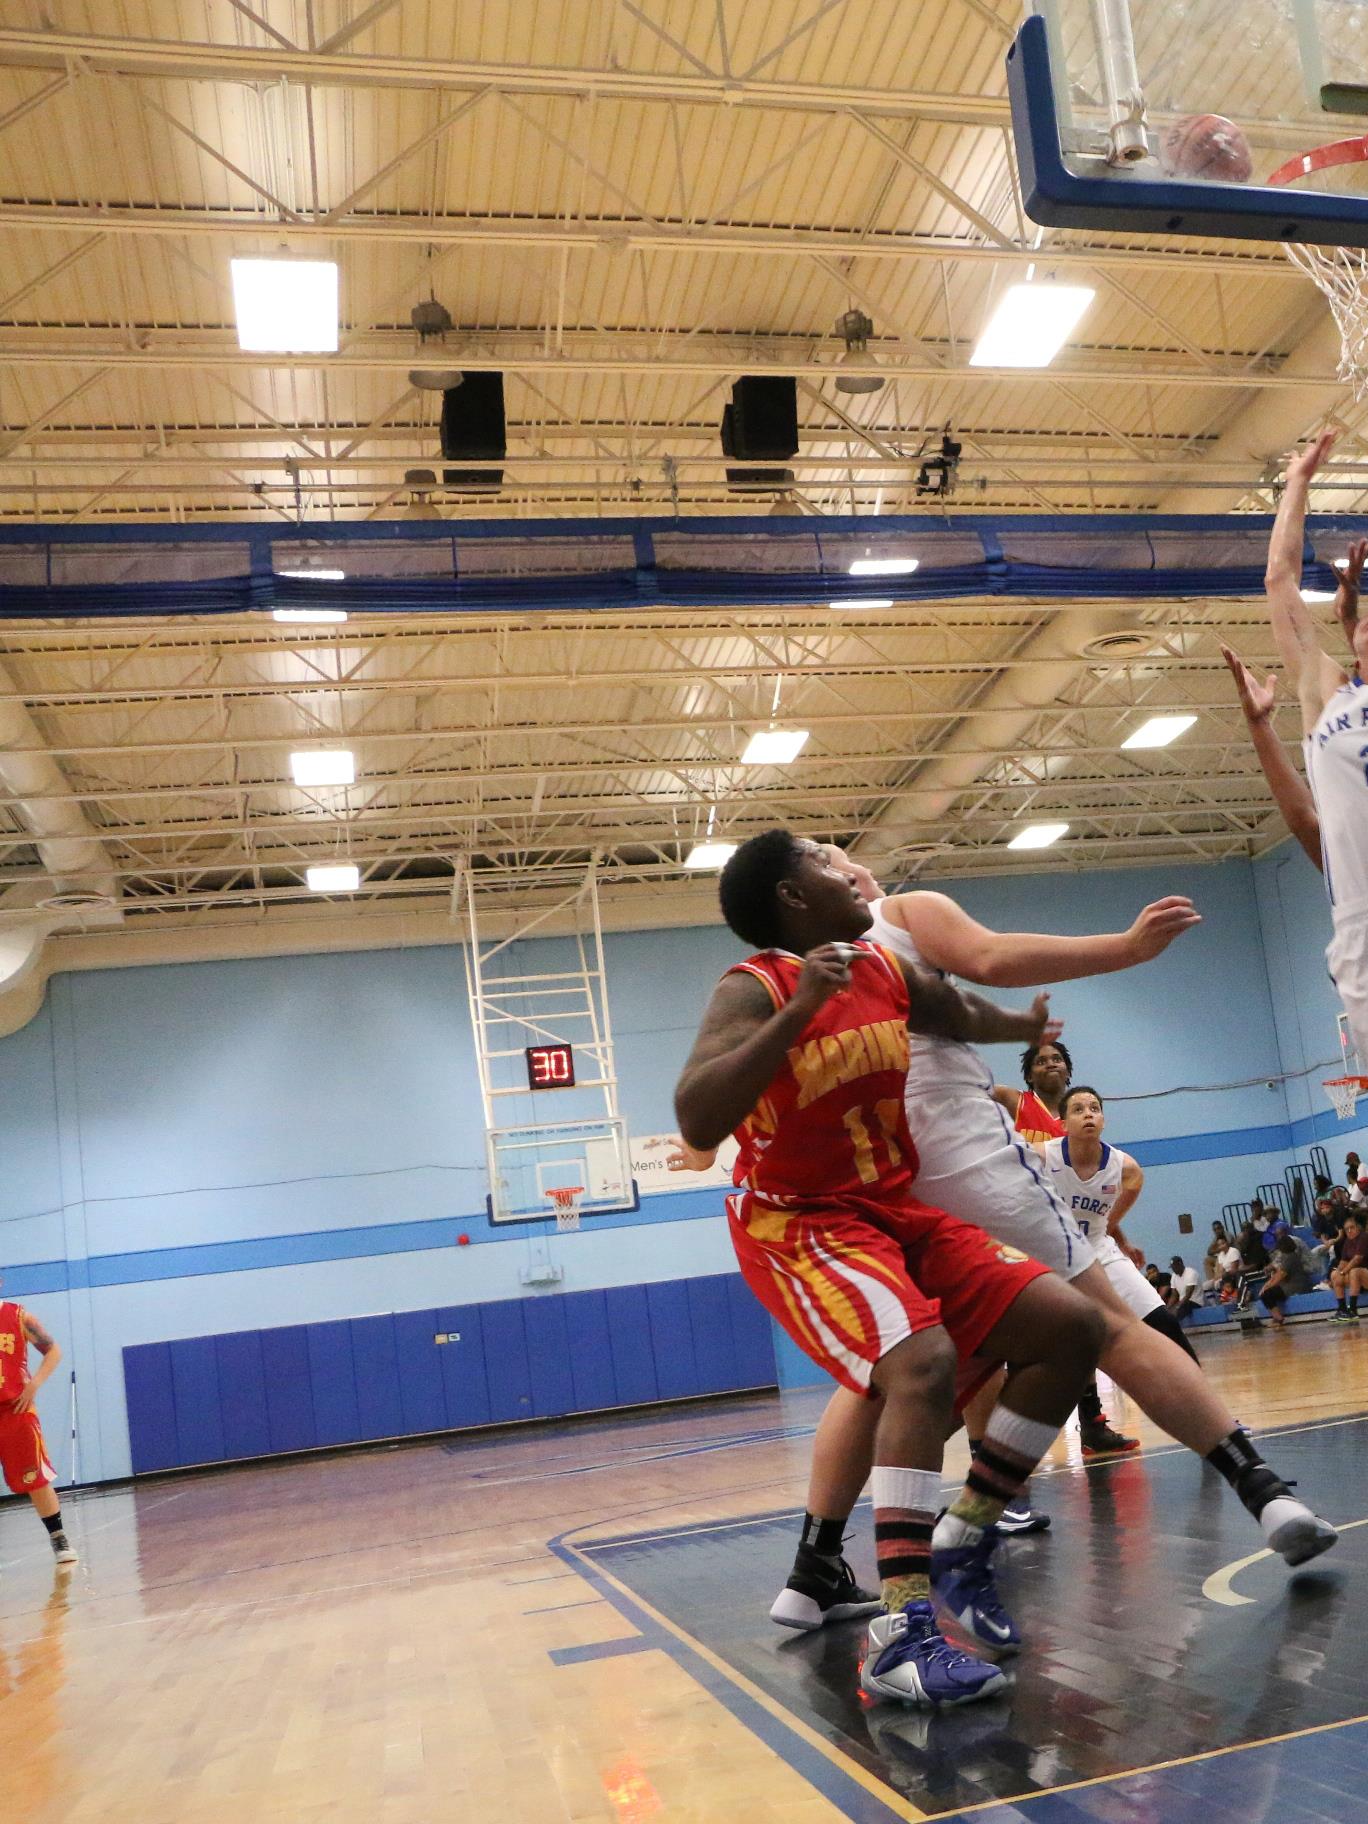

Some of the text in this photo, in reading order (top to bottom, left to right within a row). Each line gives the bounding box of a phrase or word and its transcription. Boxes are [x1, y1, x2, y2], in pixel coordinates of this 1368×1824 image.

[533, 1050, 569, 1081] 30
[842, 1099, 902, 1184] 11
[631, 1160, 663, 1171] Men's
